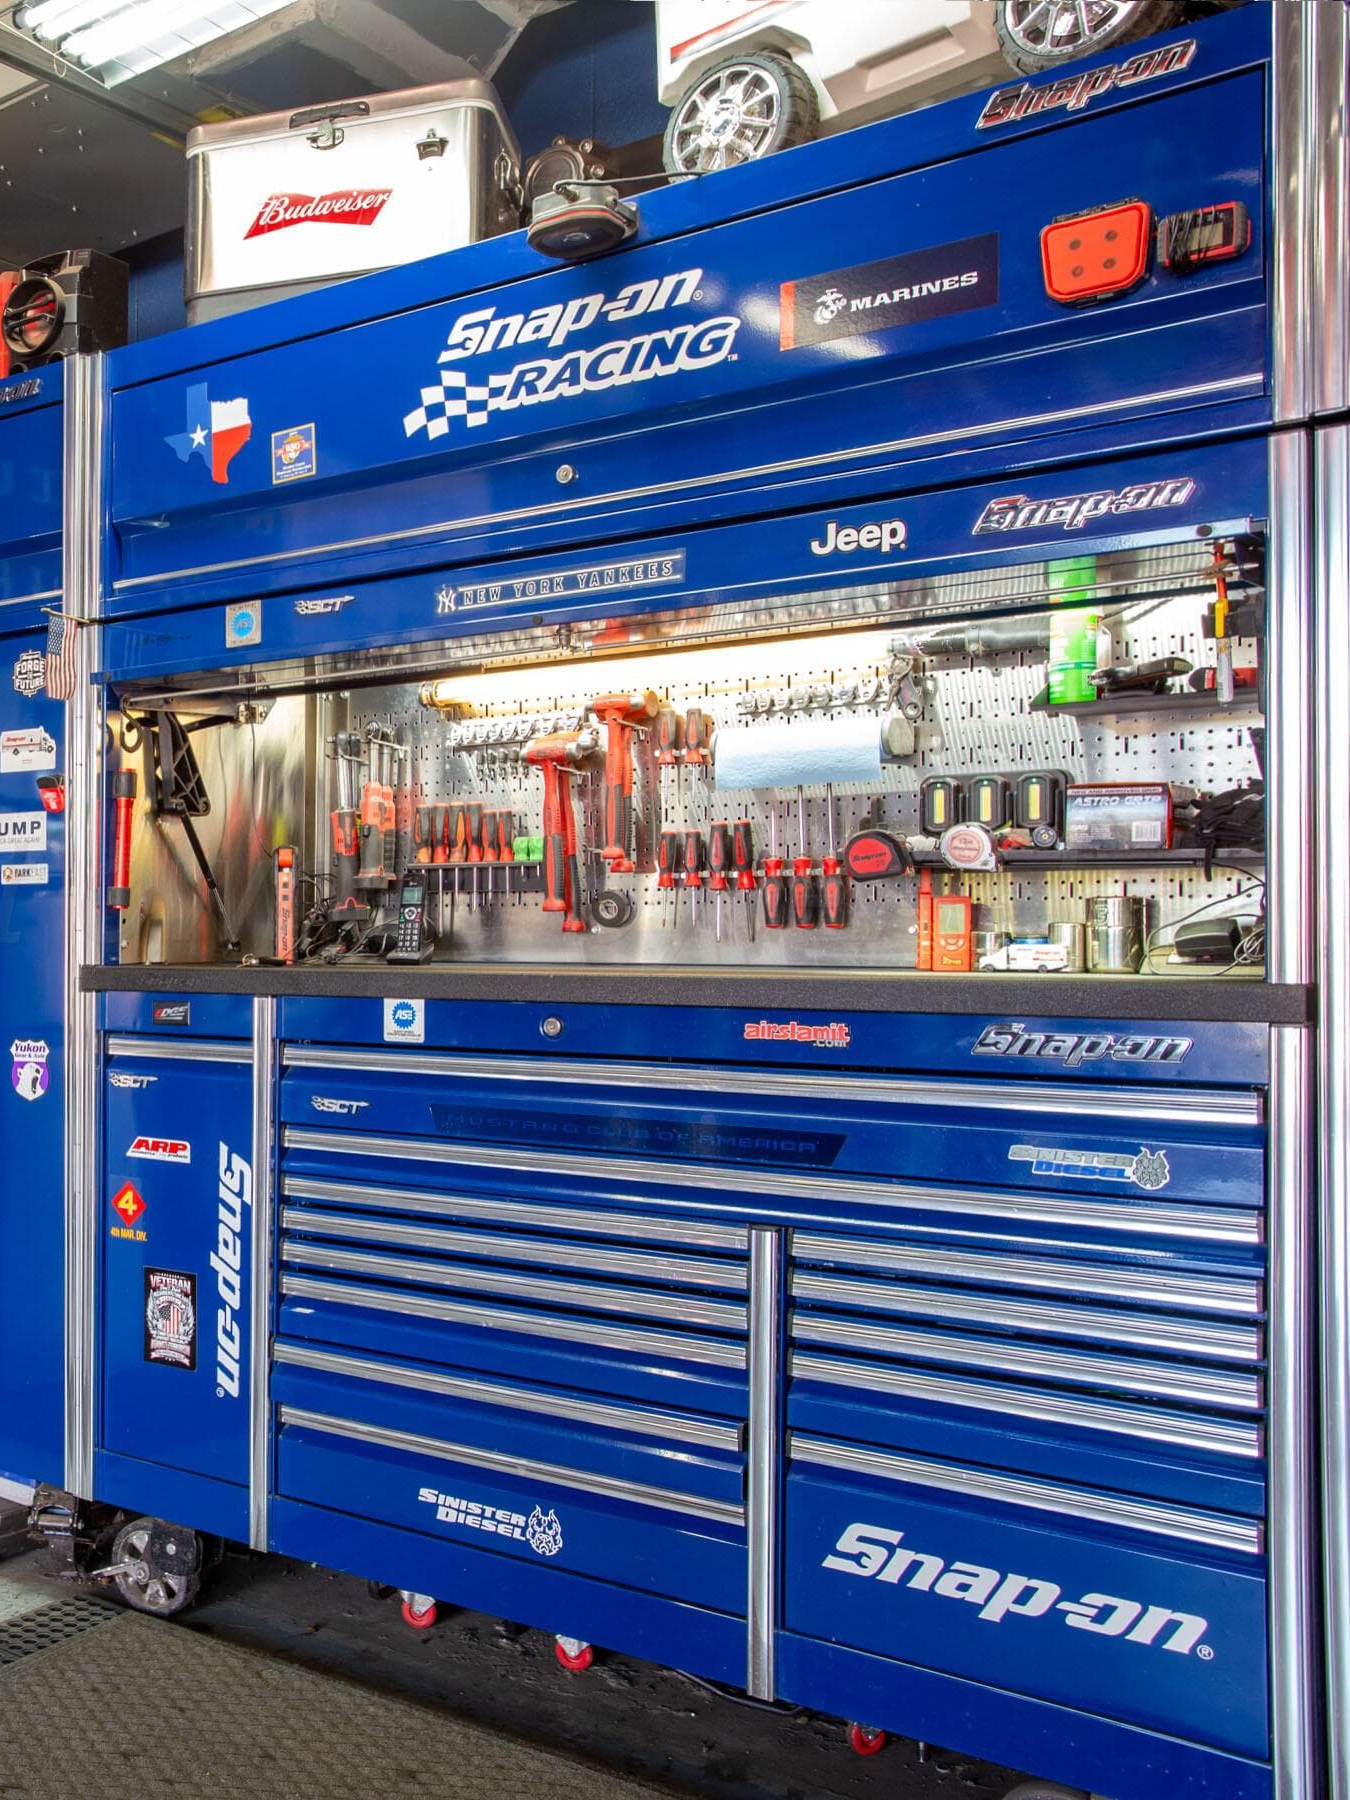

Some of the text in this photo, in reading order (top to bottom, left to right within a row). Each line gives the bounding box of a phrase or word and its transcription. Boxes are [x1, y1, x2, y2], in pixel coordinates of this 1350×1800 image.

[974, 39, 1198, 130] Snap-on
[258, 189, 392, 228] Budweiser
[849, 270, 979, 312] MARINES
[436, 267, 704, 365] Snap-on
[505, 316, 742, 402] RACING
[971, 477, 1195, 536] Snap-on
[810, 519, 907, 557] Jeep
[463, 586, 501, 606] NEW
[513, 576, 564, 598] YORK
[576, 560, 673, 589] YANKEES
[305, 597, 347, 614] SCT
[16, 660, 45, 673] FORGE
[15, 676, 45, 690] FUTURE
[393, 1009, 413, 1021] ASE
[743, 1020, 851, 1042] airslamit
[812, 1038, 847, 1048] .com
[14, 1042, 46, 1053] Yukon
[970, 1022, 1194, 1068] Snap-on
[116, 1074, 152, 1090] SCT
[322, 1097, 362, 1115] SCT
[132, 1138, 188, 1154] ARP
[446, 1113, 579, 1135] MUSTANG
[697, 1134, 817, 1153] AMERICA
[1008, 1145, 1135, 1167] SINISTER
[1034, 1160, 1131, 1181] DIESEL
[117, 1190, 138, 1216] 4
[110, 1226, 149, 1242] 4th MAR. DIV.
[209, 1140, 252, 1398] Snap-on
[149, 1274, 191, 1294] VETERAN
[417, 1487, 527, 1527] SINISTER
[436, 1505, 527, 1541] DIESEL
[820, 1522, 1210, 1658] Snap-on
